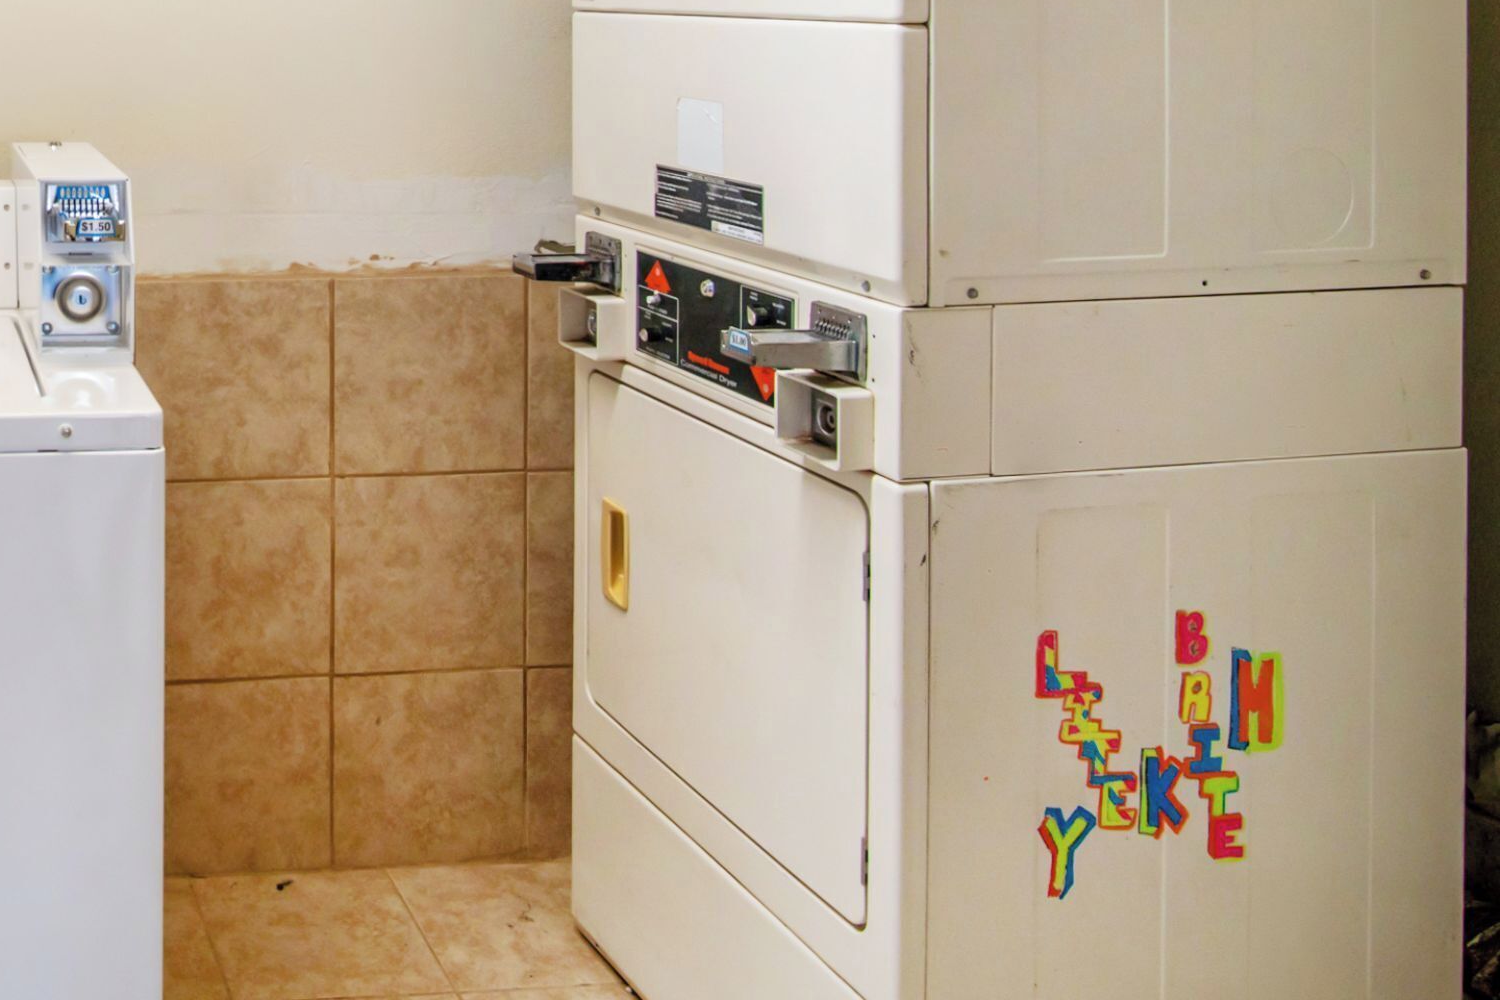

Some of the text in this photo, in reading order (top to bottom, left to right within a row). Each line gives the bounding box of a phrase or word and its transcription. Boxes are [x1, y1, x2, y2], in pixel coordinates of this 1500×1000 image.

[81, 222, 111, 231] $1.50
[680, 359, 718, 379] Commercial
[719, 374, 737, 387] Dryer
